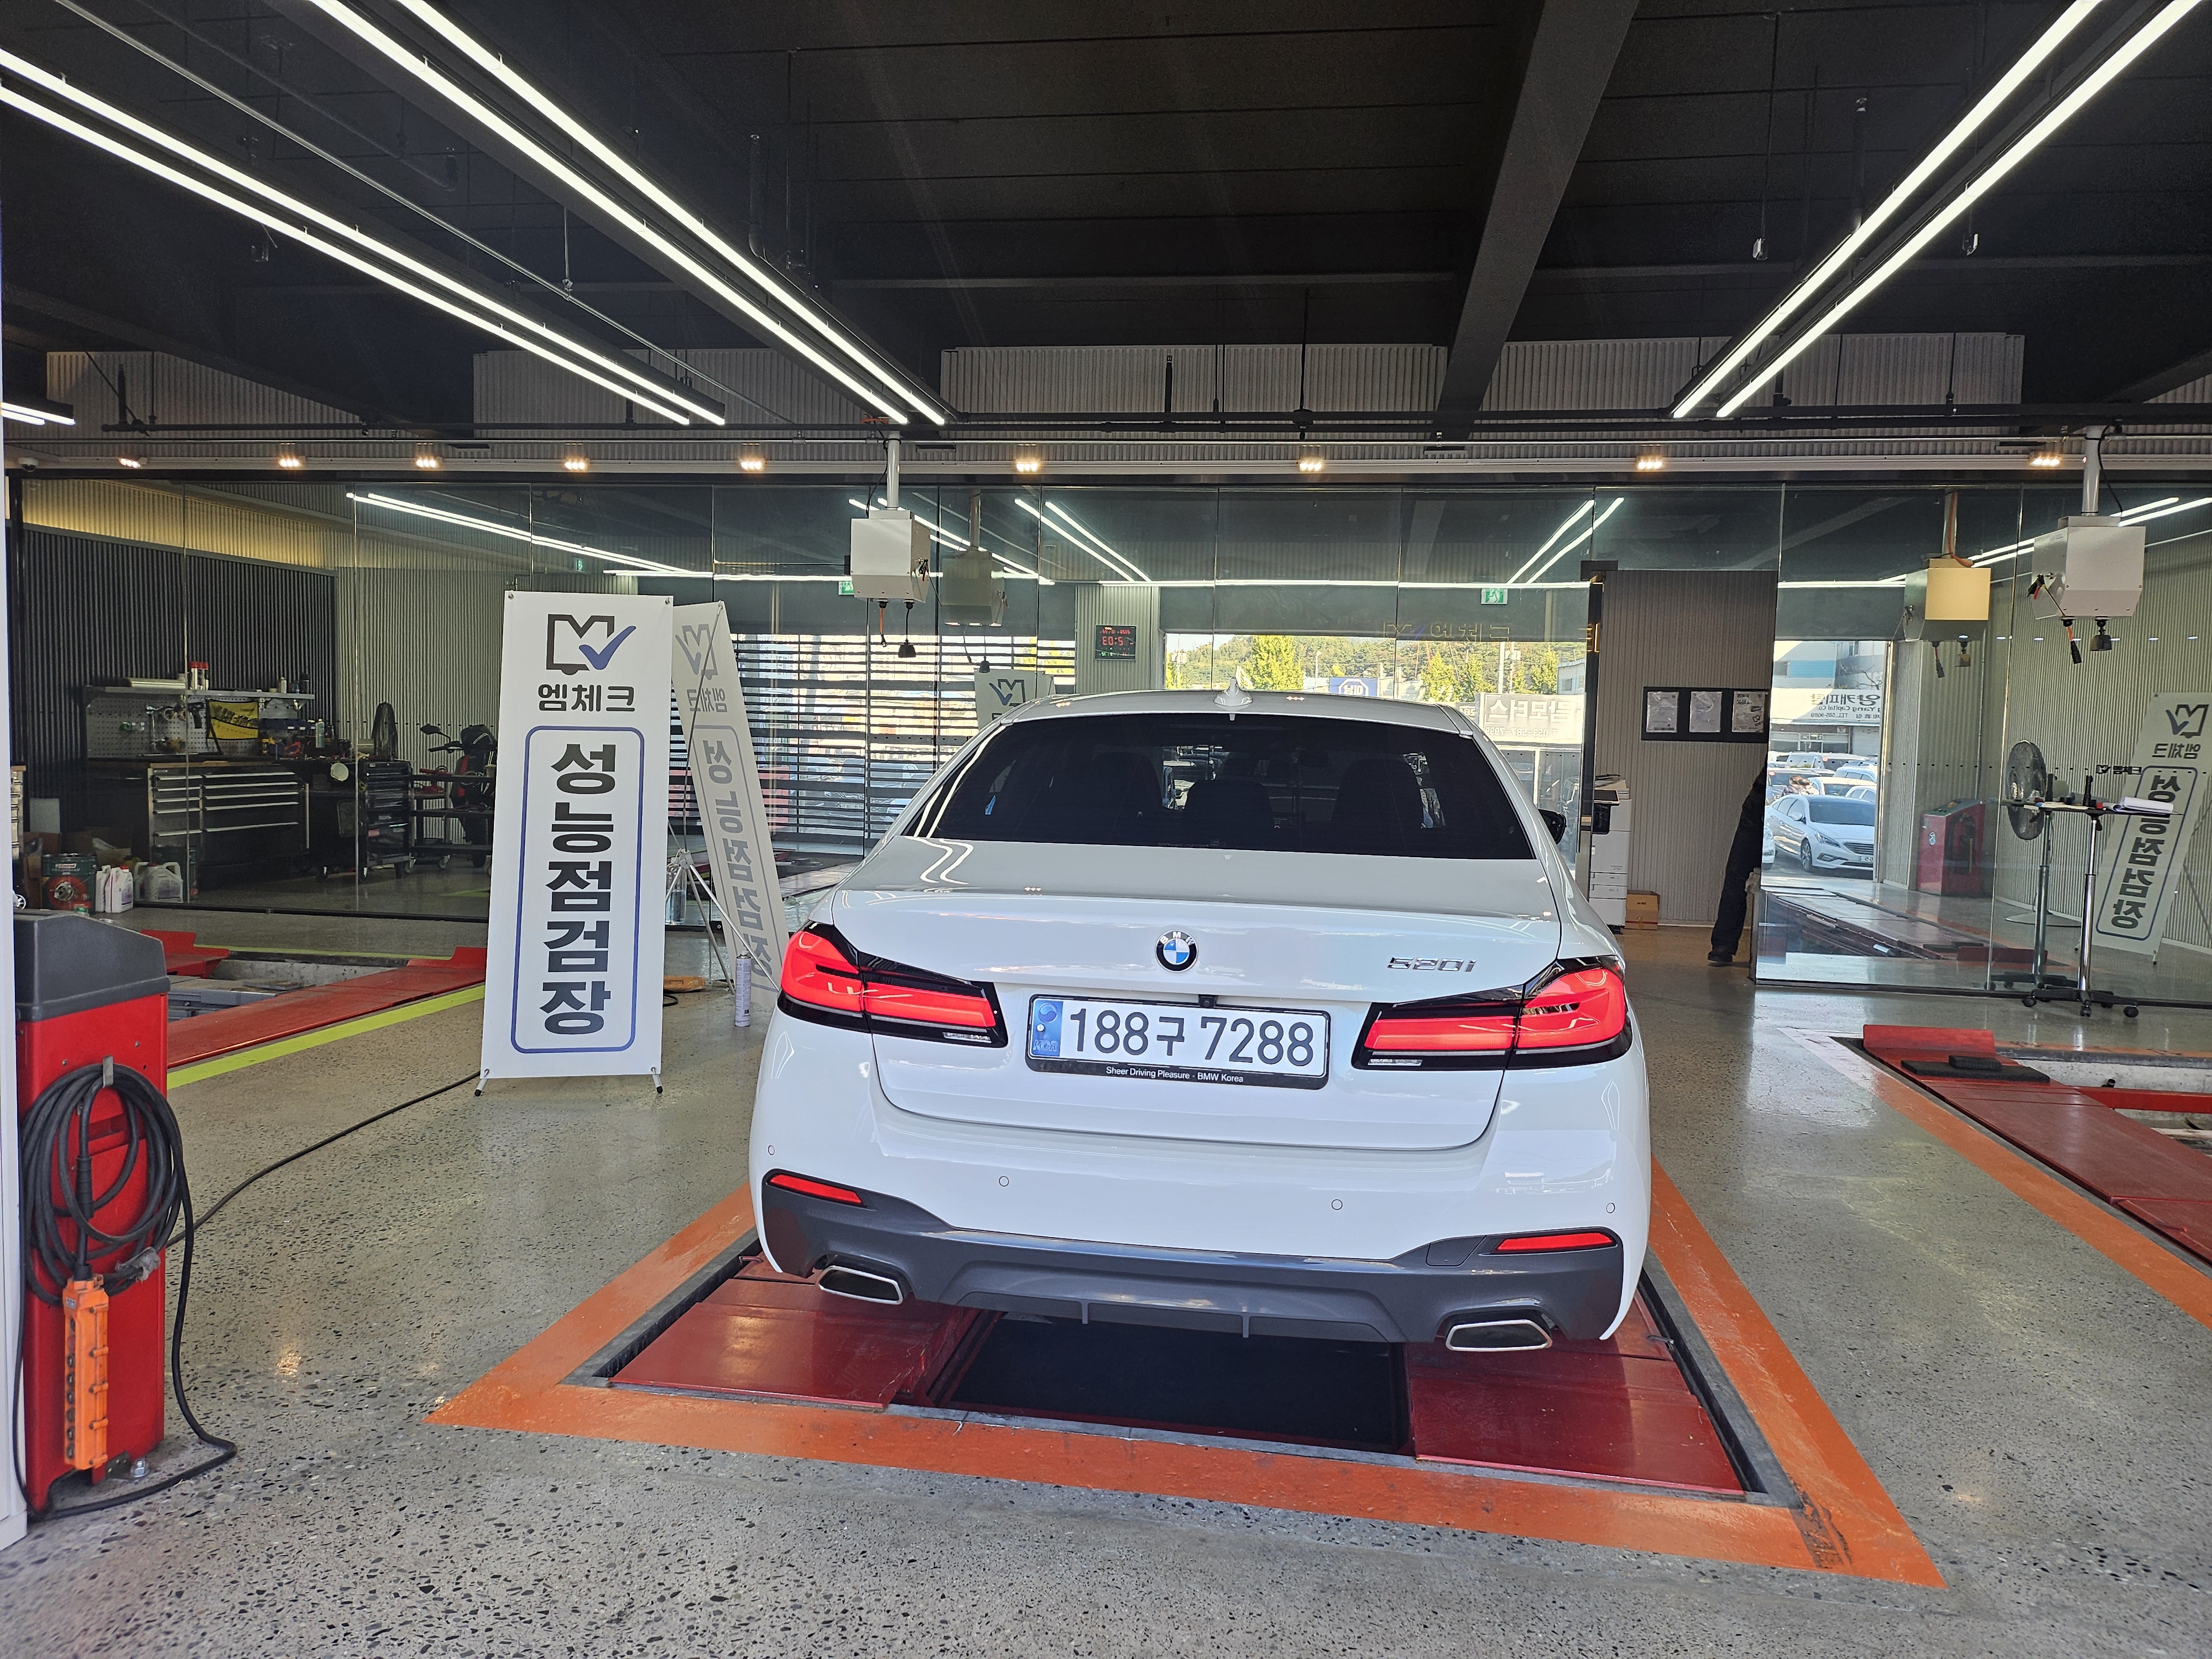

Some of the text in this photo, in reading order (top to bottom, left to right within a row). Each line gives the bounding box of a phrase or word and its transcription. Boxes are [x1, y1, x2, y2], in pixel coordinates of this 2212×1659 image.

[538, 684, 635, 712] 엠체크
[539, 743, 617, 1035] 성능점검장
[1160, 931, 1195, 946] BMW
[1387, 956, 1477, 972] 520i
[1032, 1040, 1058, 1052] KOR
[1070, 1008, 1314, 1067] 188구 7288
[1105, 1066, 1244, 1083] Sheer Driving Pleasure BMW Korea
